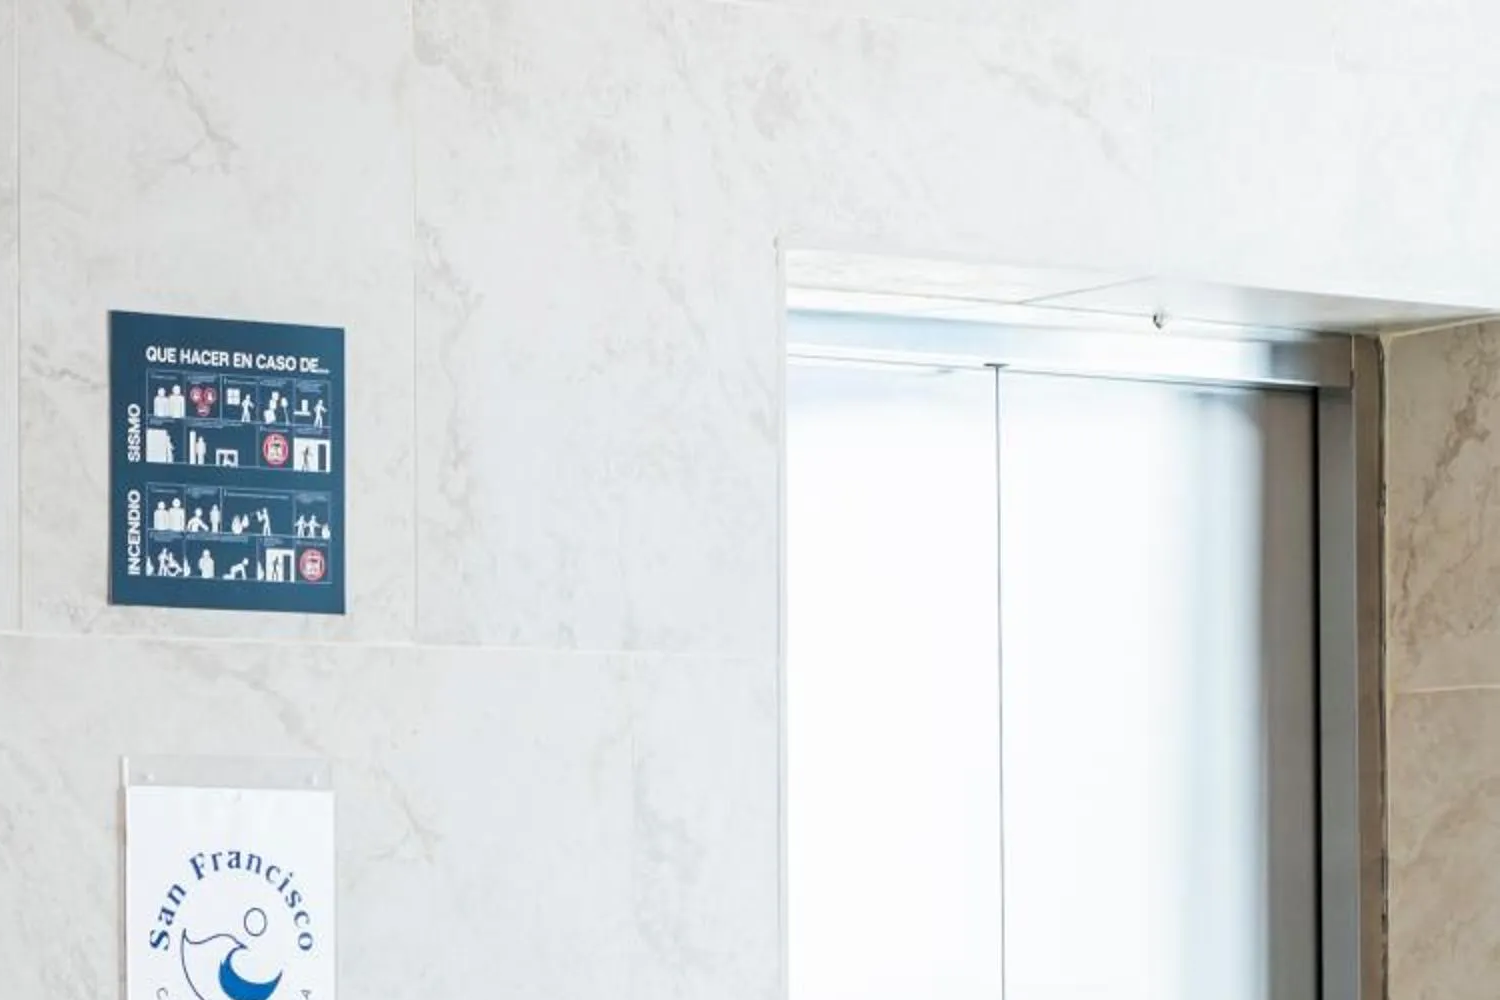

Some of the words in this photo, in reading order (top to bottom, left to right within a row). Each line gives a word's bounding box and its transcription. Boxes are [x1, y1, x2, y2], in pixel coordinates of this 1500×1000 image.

[145, 345, 177, 364] QUE
[179, 347, 230, 368] HACER
[232, 351, 253, 369] EN
[255, 353, 297, 372] CASO
[127, 403, 141, 463] SISMO
[127, 489, 141, 576] INCENDIO
[148, 882, 187, 953] San
[188, 849, 315, 953] Francisco
